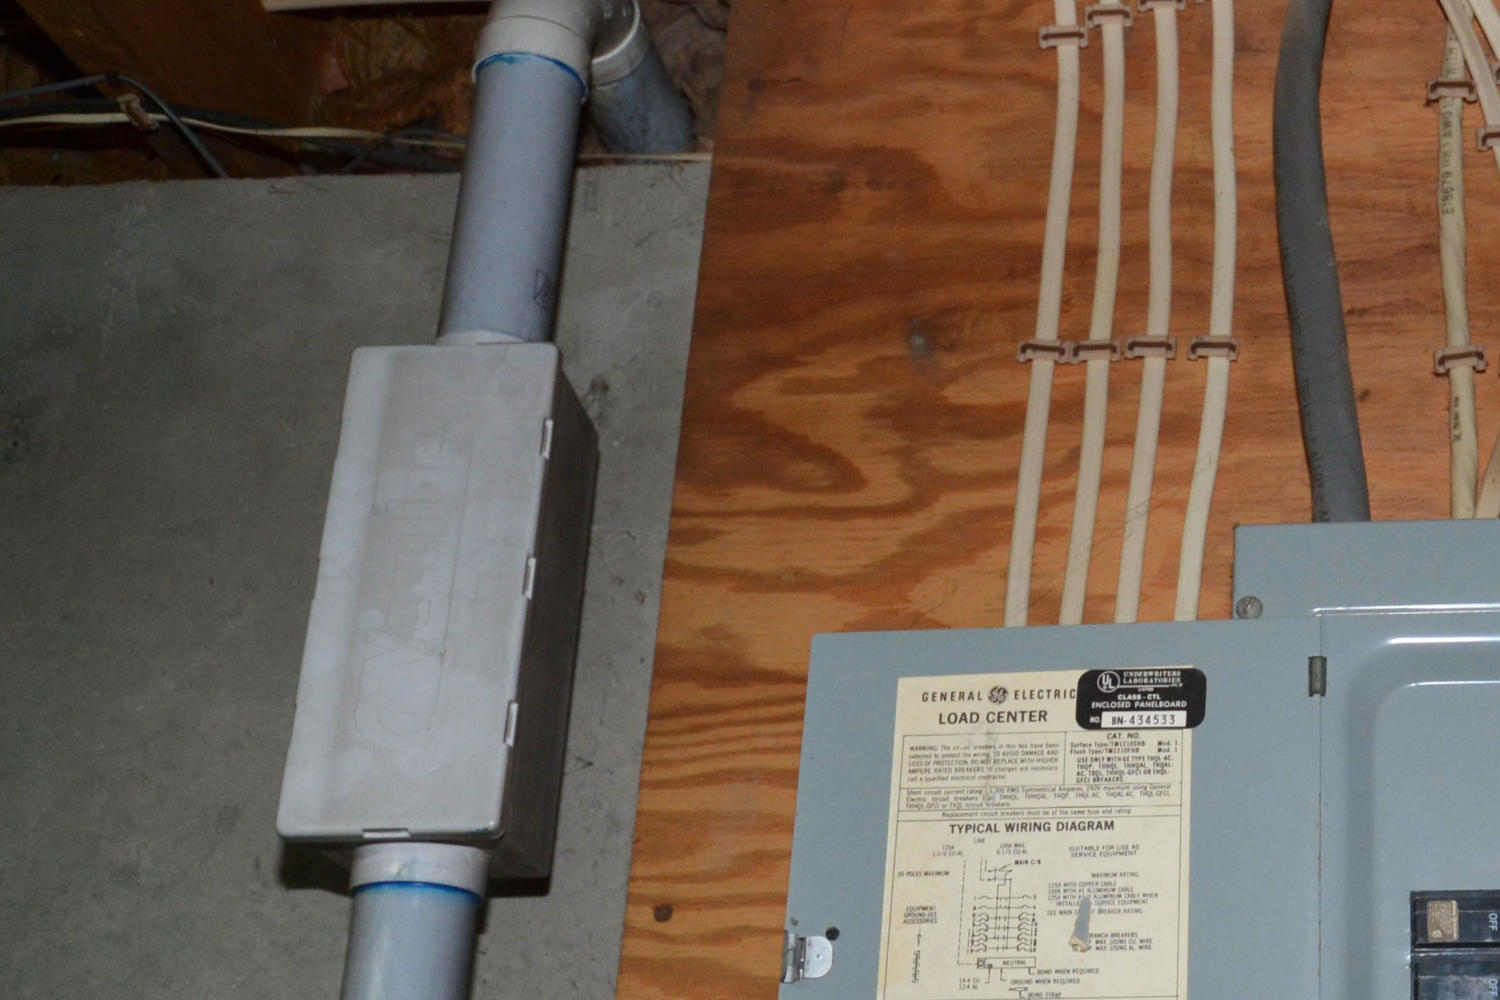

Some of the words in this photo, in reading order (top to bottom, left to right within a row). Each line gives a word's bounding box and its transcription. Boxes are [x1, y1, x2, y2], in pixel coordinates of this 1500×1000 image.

[922, 690, 982, 702] GENERAL
[1014, 688, 1075, 700] ELECTRIC
[939, 712, 979, 724] LOAD
[986, 710, 1048, 723] CENTER
[1112, 714, 1175, 725] BN-434533
[950, 824, 999, 834] TYPICAL
[1005, 822, 1050, 833] WIRING
[1057, 821, 1114, 831] DIAGRAM
[1489, 913, 1498, 930] OFF
[1488, 979, 1498, 996] OFF
